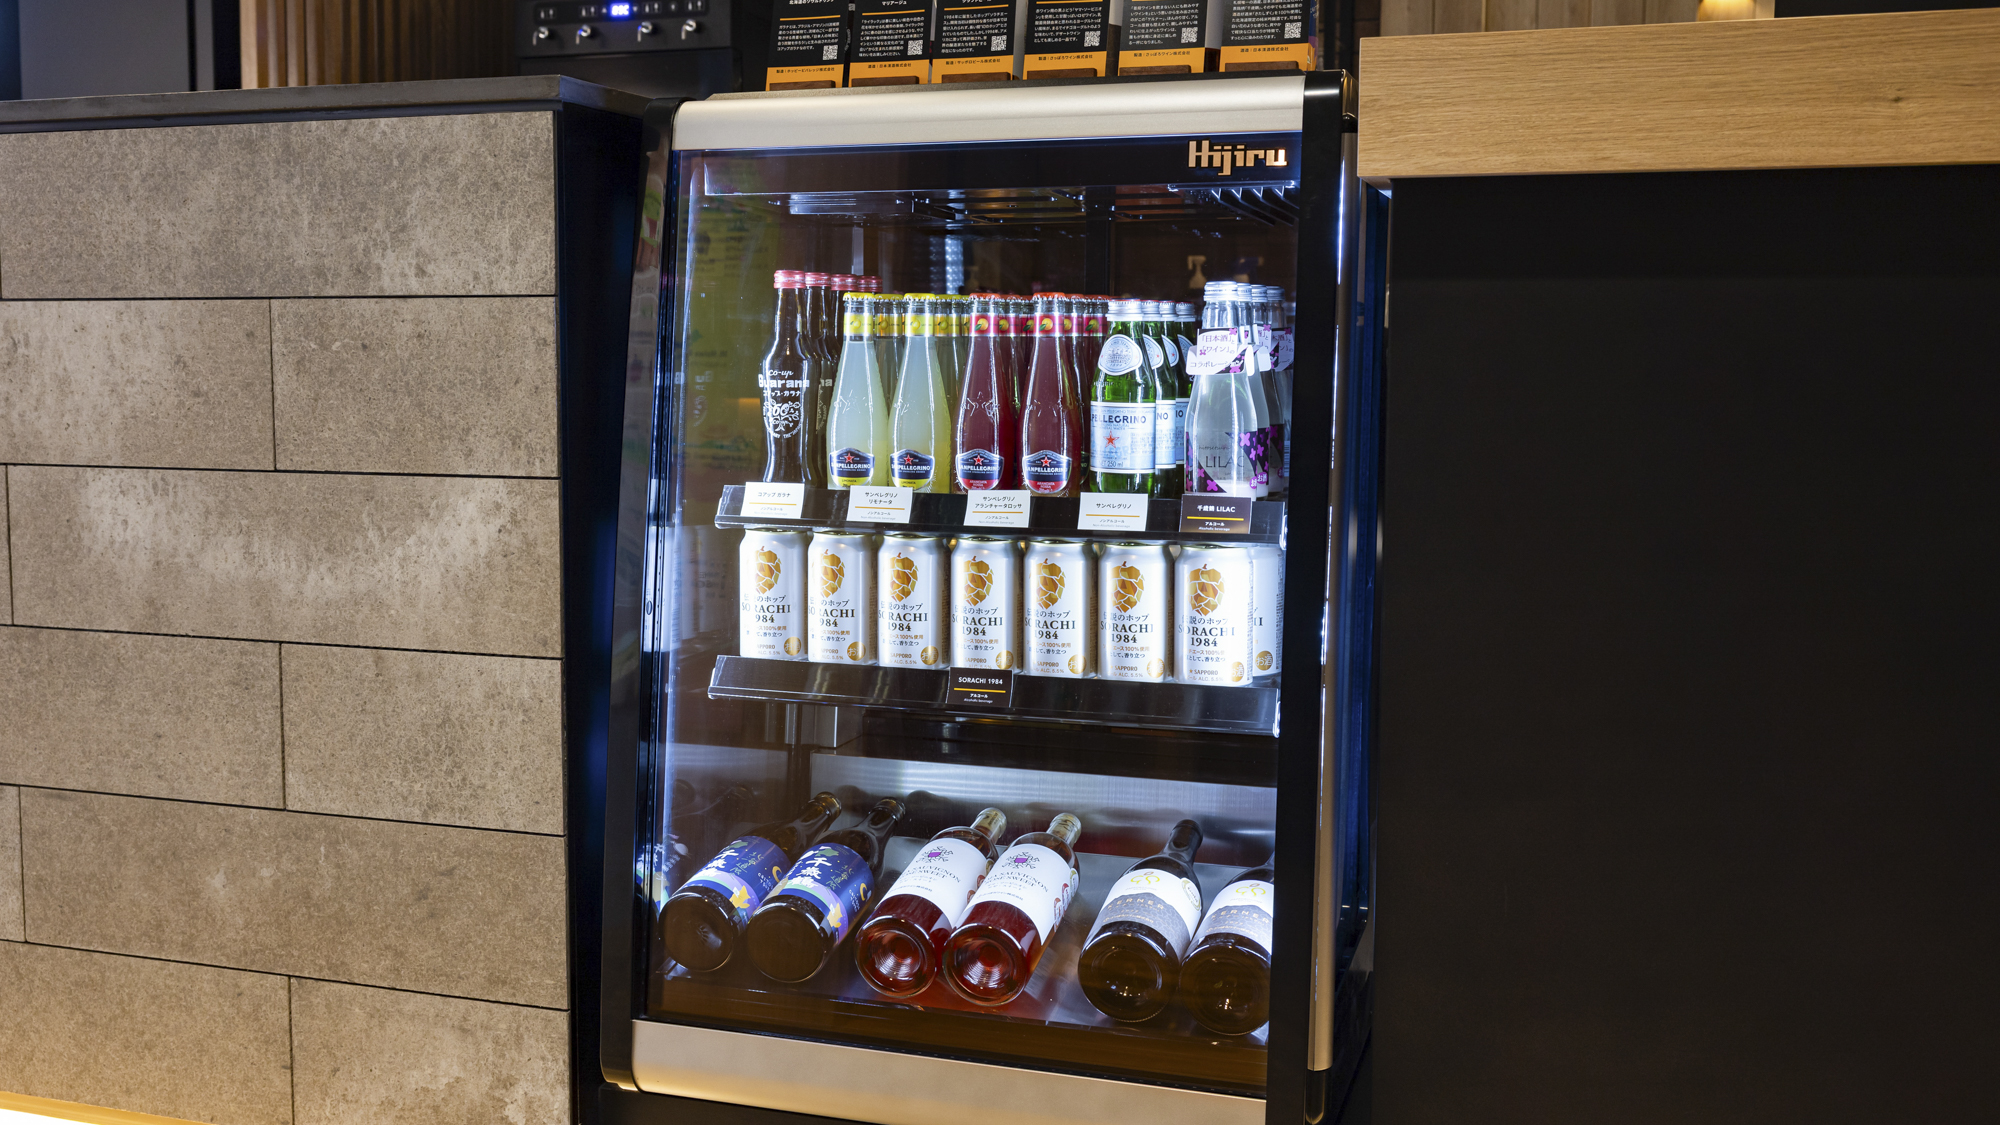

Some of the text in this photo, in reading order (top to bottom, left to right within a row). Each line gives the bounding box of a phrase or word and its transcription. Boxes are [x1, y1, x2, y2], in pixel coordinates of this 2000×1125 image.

[1188, 139, 1288, 176] Hijiru
[1216, 505, 1236, 513] LILAC
[1111, 634, 1138, 643] 1984
[1191, 637, 1218, 647] 1984
[958, 676, 987, 684] SORACHI
[1108, 898, 1164, 911] KERNER
[1211, 909, 1269, 924] KERNER
